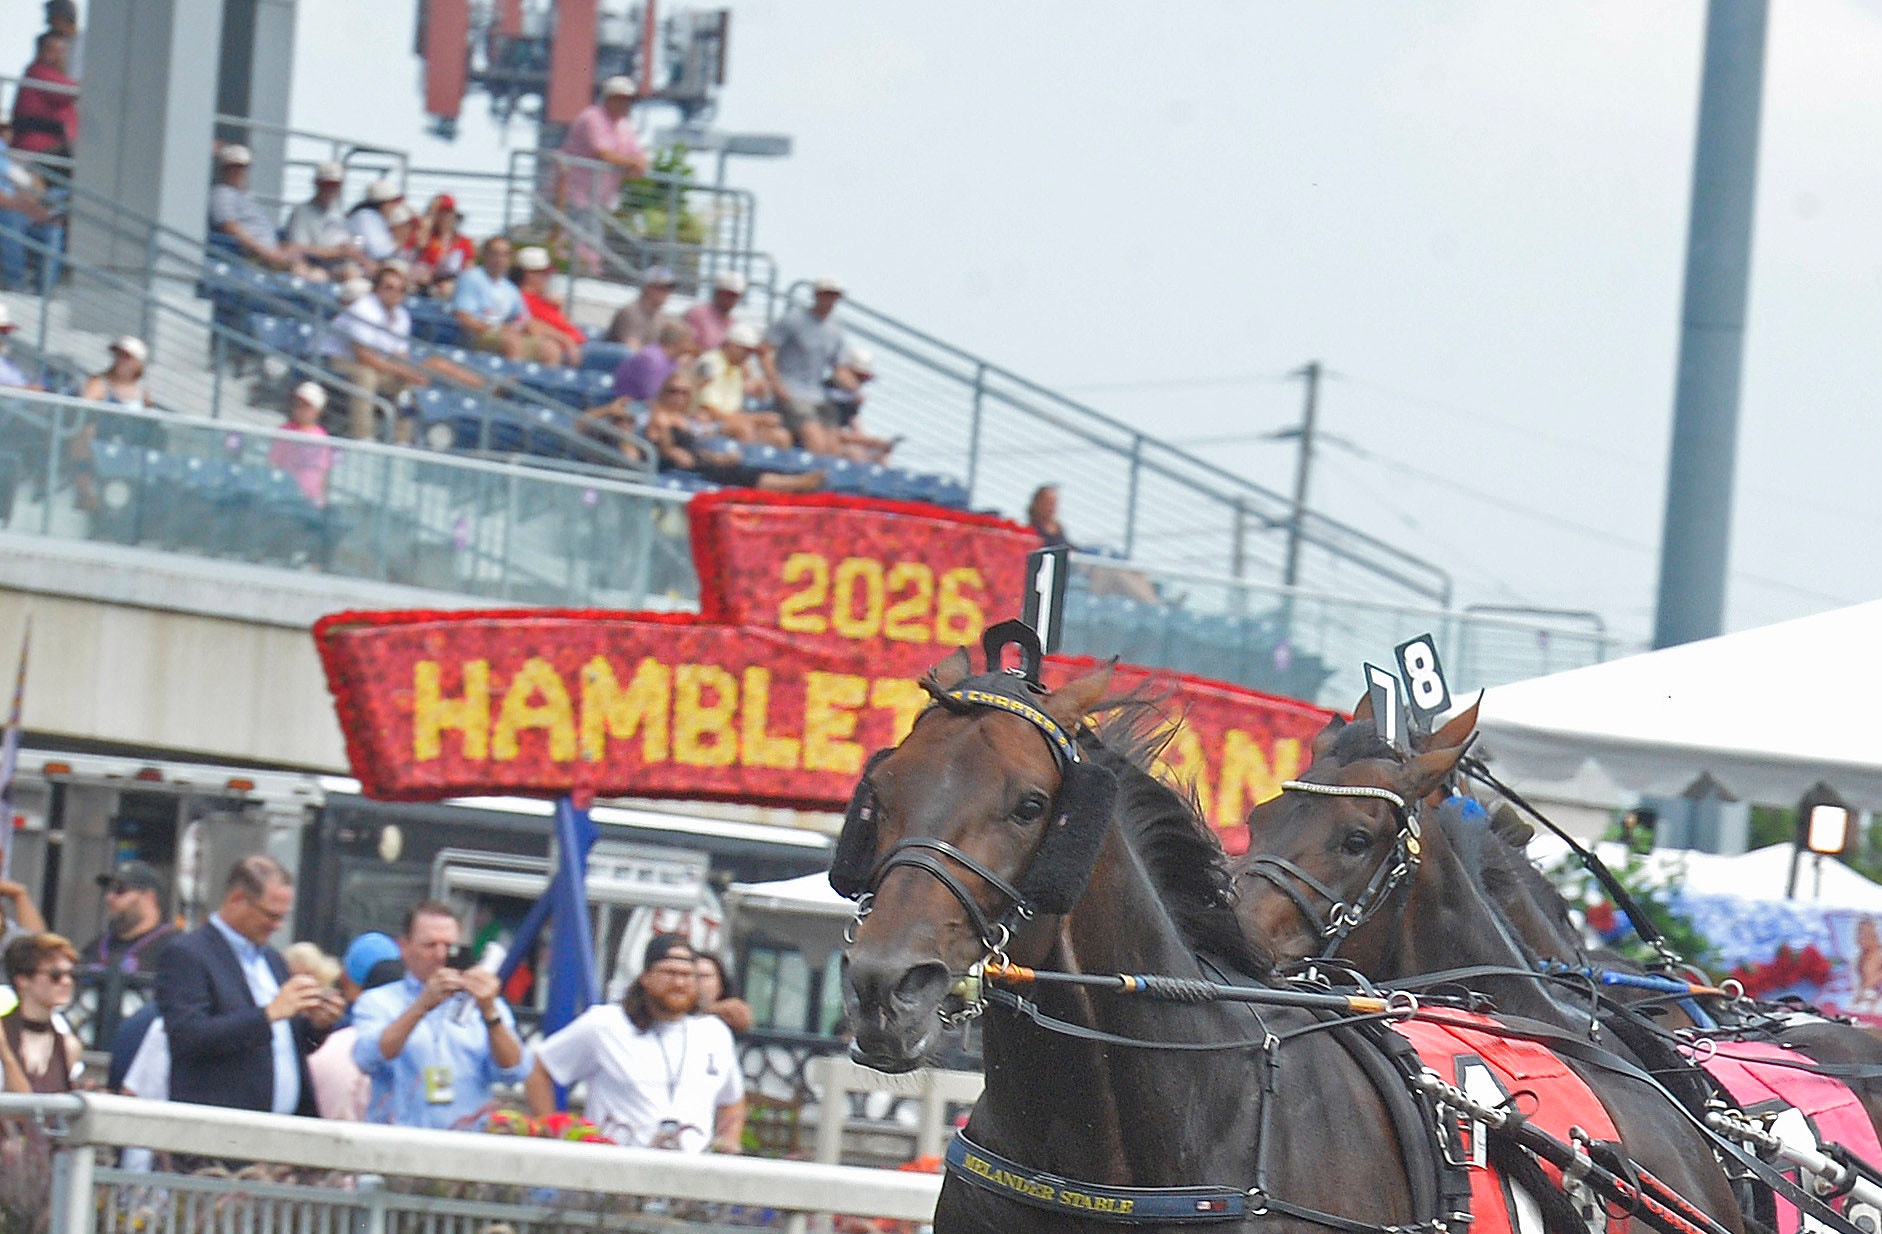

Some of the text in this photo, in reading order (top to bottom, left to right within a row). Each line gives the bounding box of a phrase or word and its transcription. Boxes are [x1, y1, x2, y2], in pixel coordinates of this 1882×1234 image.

[779, 552, 985, 647] 2026
[1035, 552, 1056, 656] 1
[1403, 641, 1444, 710] 8
[962, 1153, 1134, 1215] MELANDER STABLE
